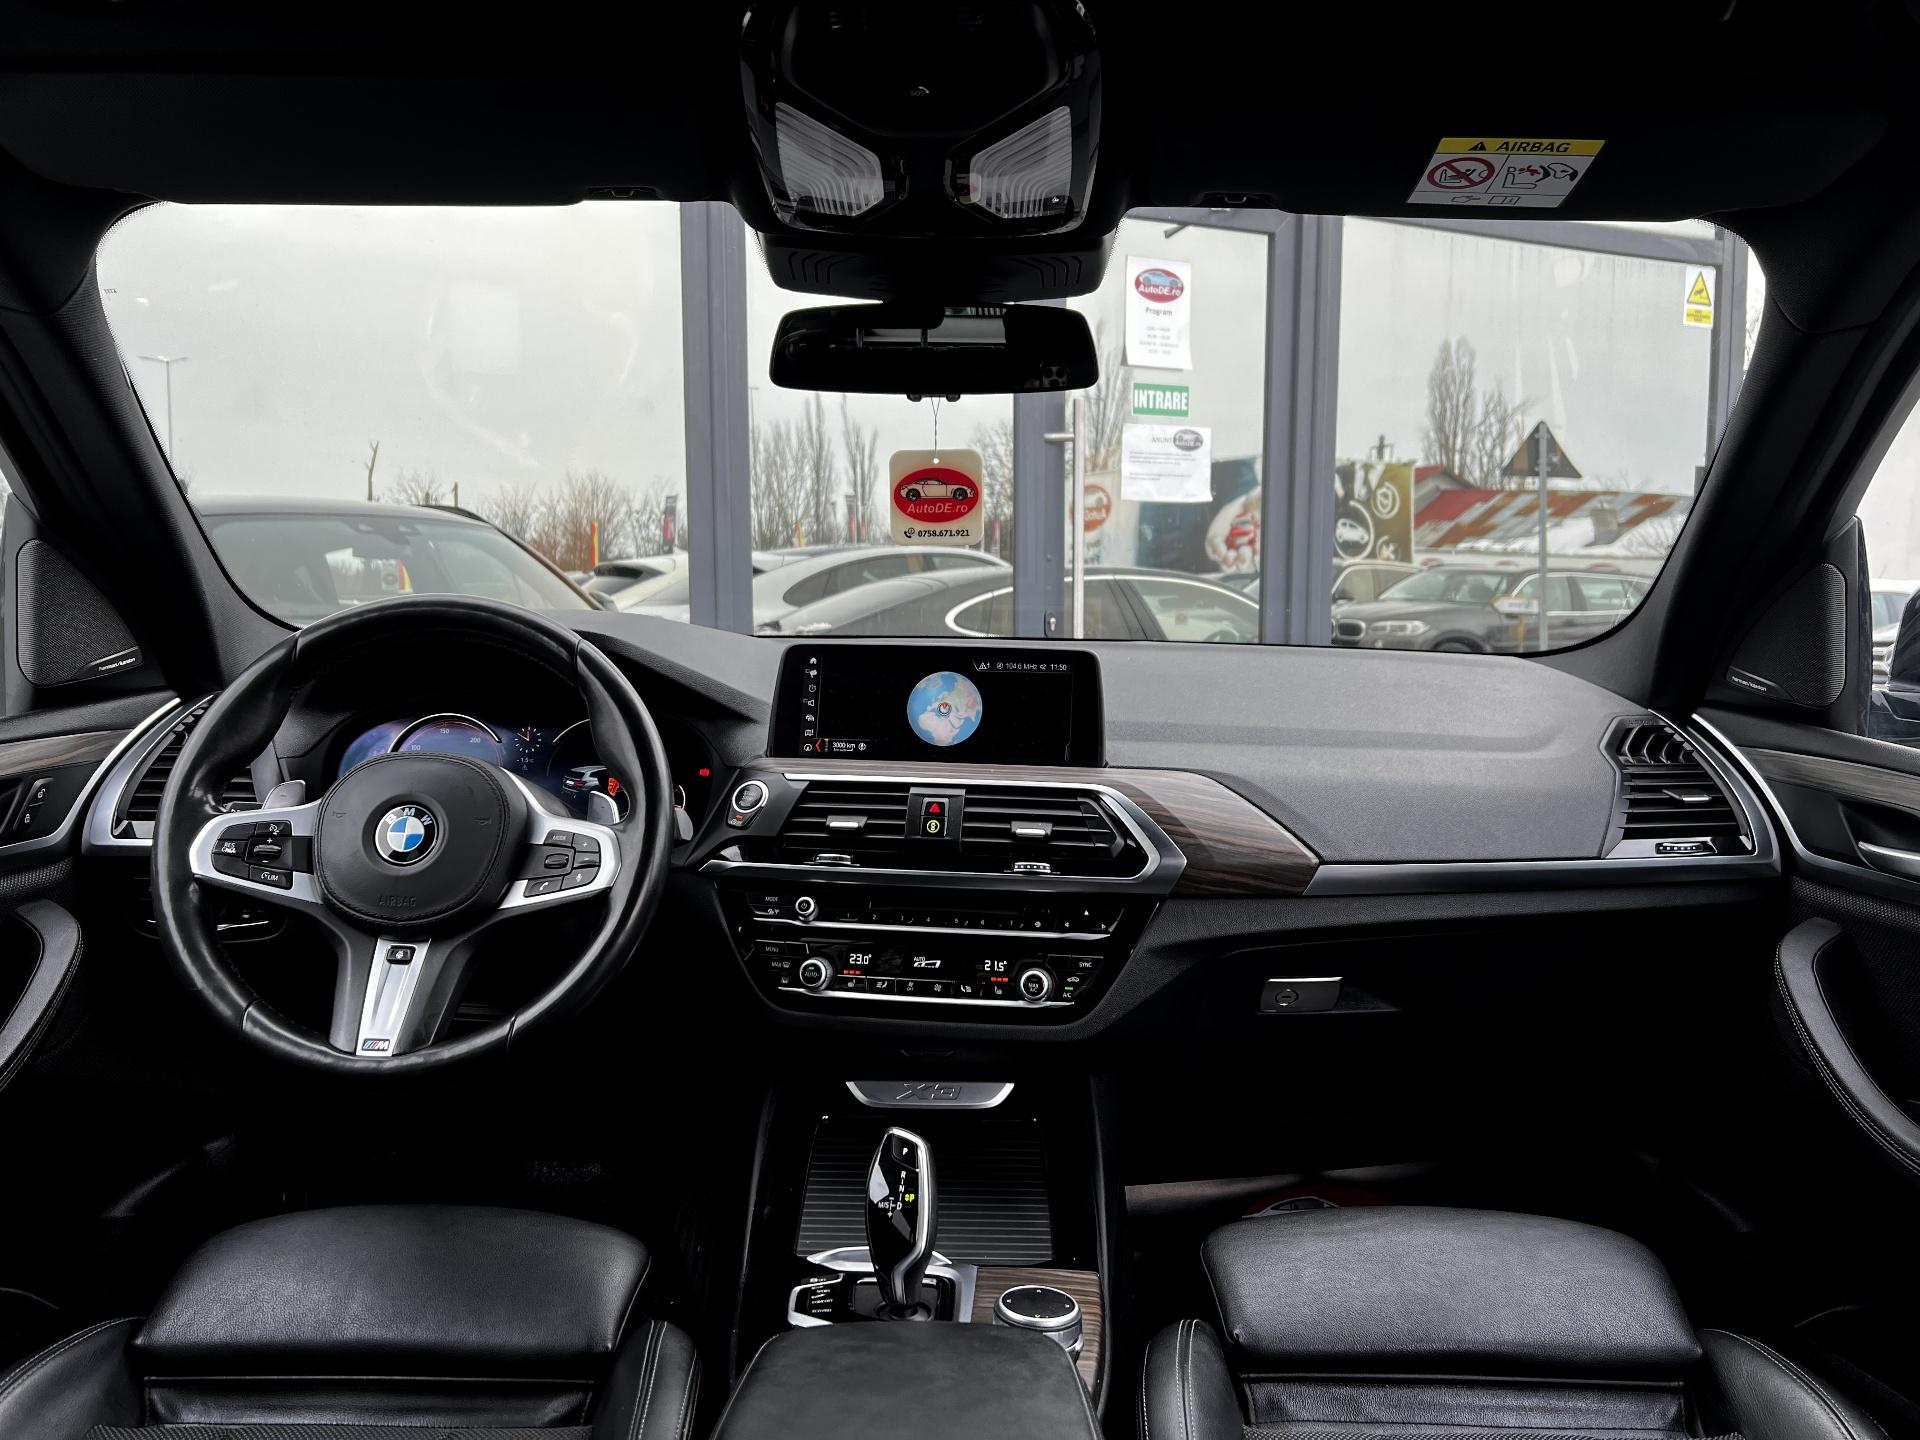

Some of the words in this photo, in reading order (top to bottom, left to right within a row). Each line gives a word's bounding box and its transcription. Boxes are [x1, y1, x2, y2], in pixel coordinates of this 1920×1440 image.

[1496, 141, 1571, 153] AIRBAG
[1138, 283, 1182, 297] AutoDE.ro
[1145, 306, 1173, 317] Program
[1134, 389, 1188, 411] INTRARE
[907, 502, 968, 514] AutoDE.ro
[918, 529, 970, 538] 0758.671.921
[384, 807, 433, 826] BMW
[378, 895, 417, 908] AIRBAG
